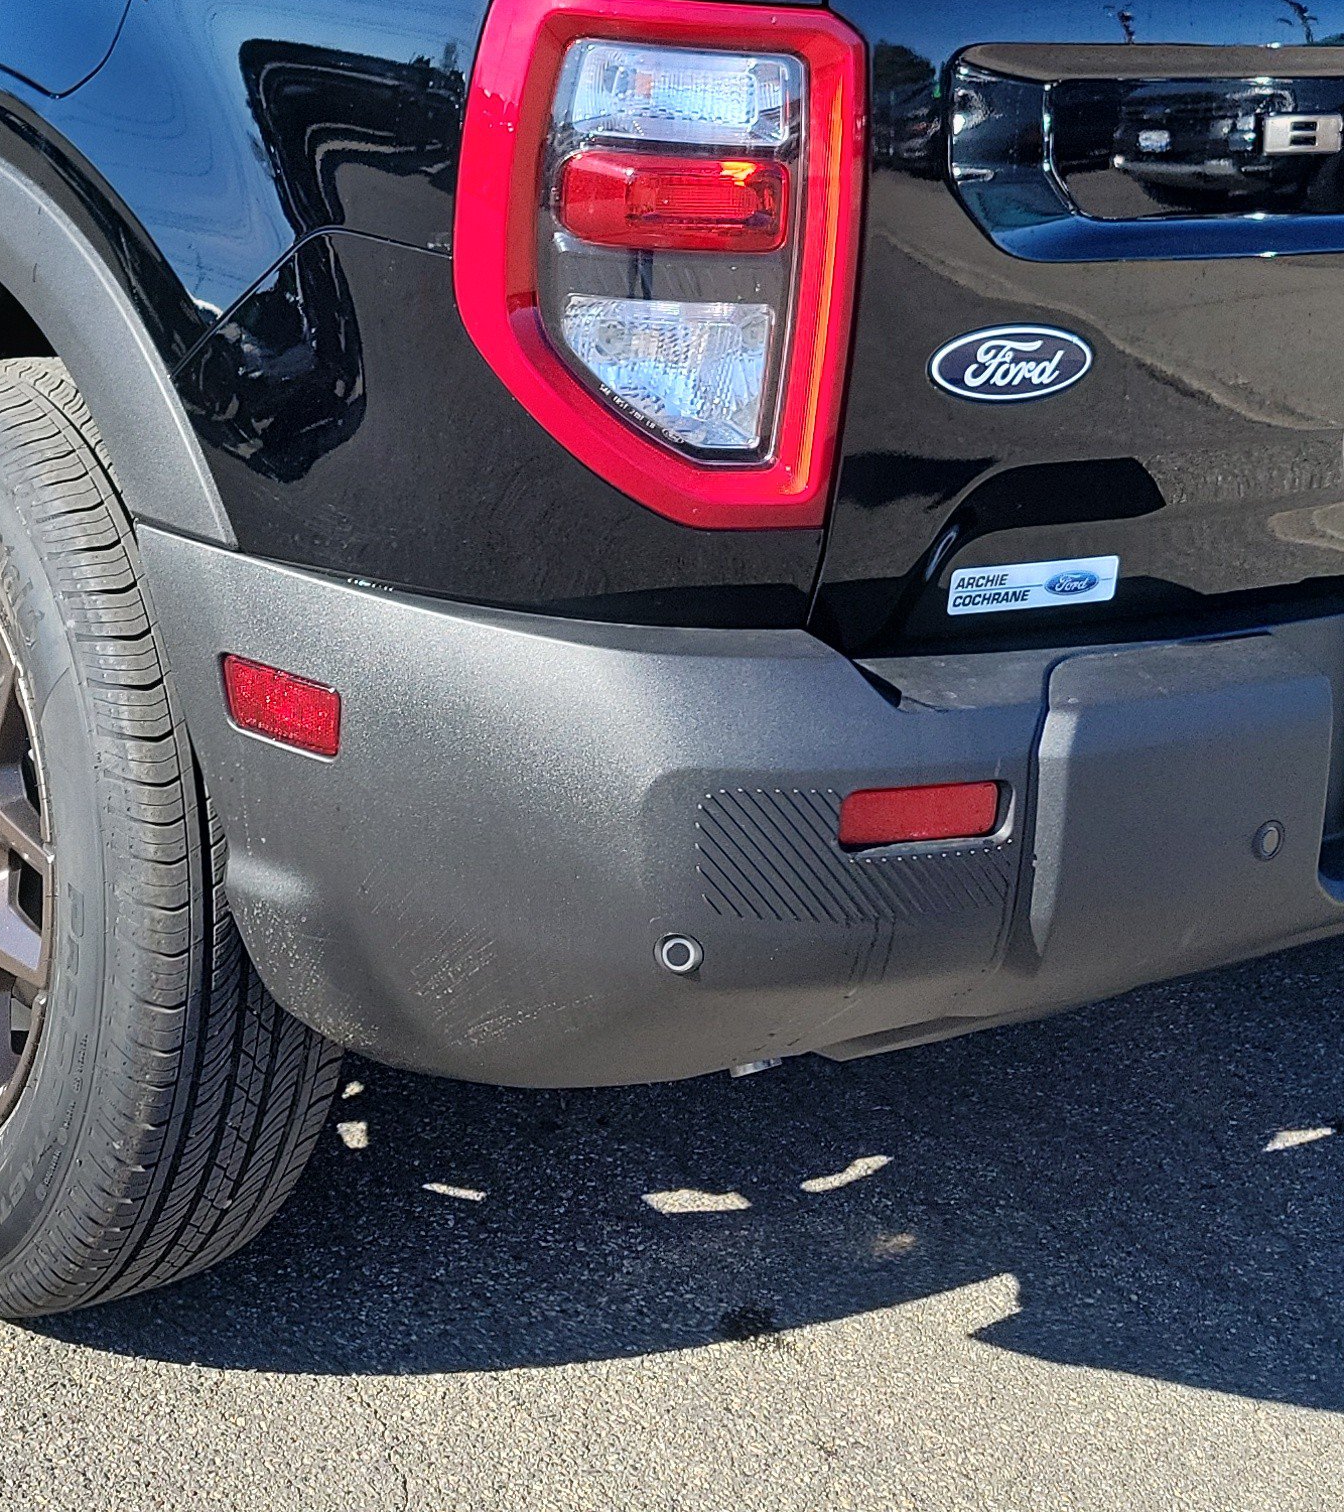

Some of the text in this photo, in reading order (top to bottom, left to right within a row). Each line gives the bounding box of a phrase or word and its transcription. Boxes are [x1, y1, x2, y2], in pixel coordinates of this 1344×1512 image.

[963, 339, 1064, 388] Ford
[956, 573, 1009, 590] ARCHIE
[1055, 573, 1089, 591] Ford
[952, 589, 1031, 608] COCHRANE
